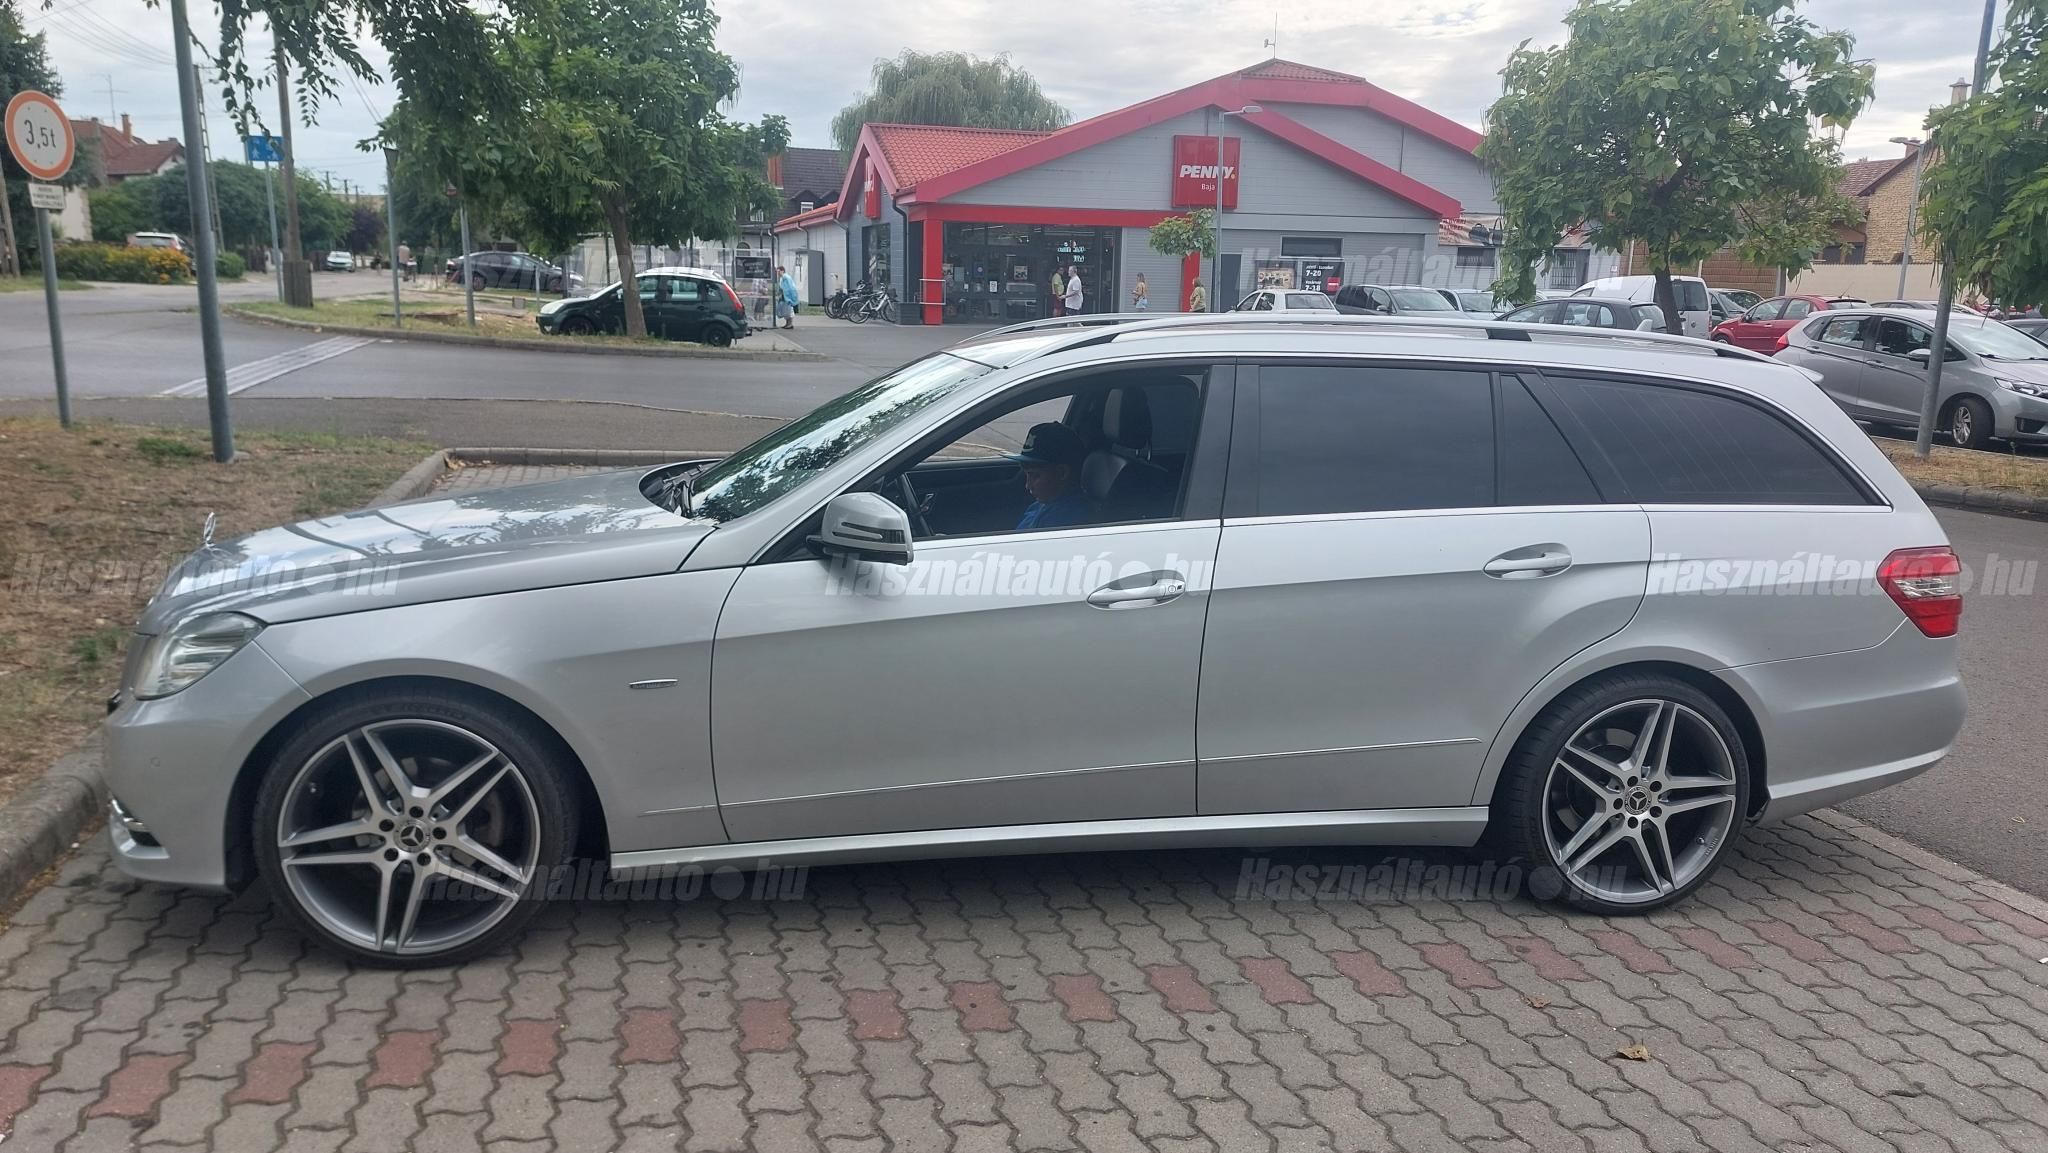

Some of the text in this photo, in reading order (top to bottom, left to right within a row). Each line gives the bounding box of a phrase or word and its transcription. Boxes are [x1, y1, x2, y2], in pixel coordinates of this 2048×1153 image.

[24, 119, 56, 149] 3,5t
[1201, 182, 1216, 192] Baja
[1305, 269, 1322, 278] 7-20
